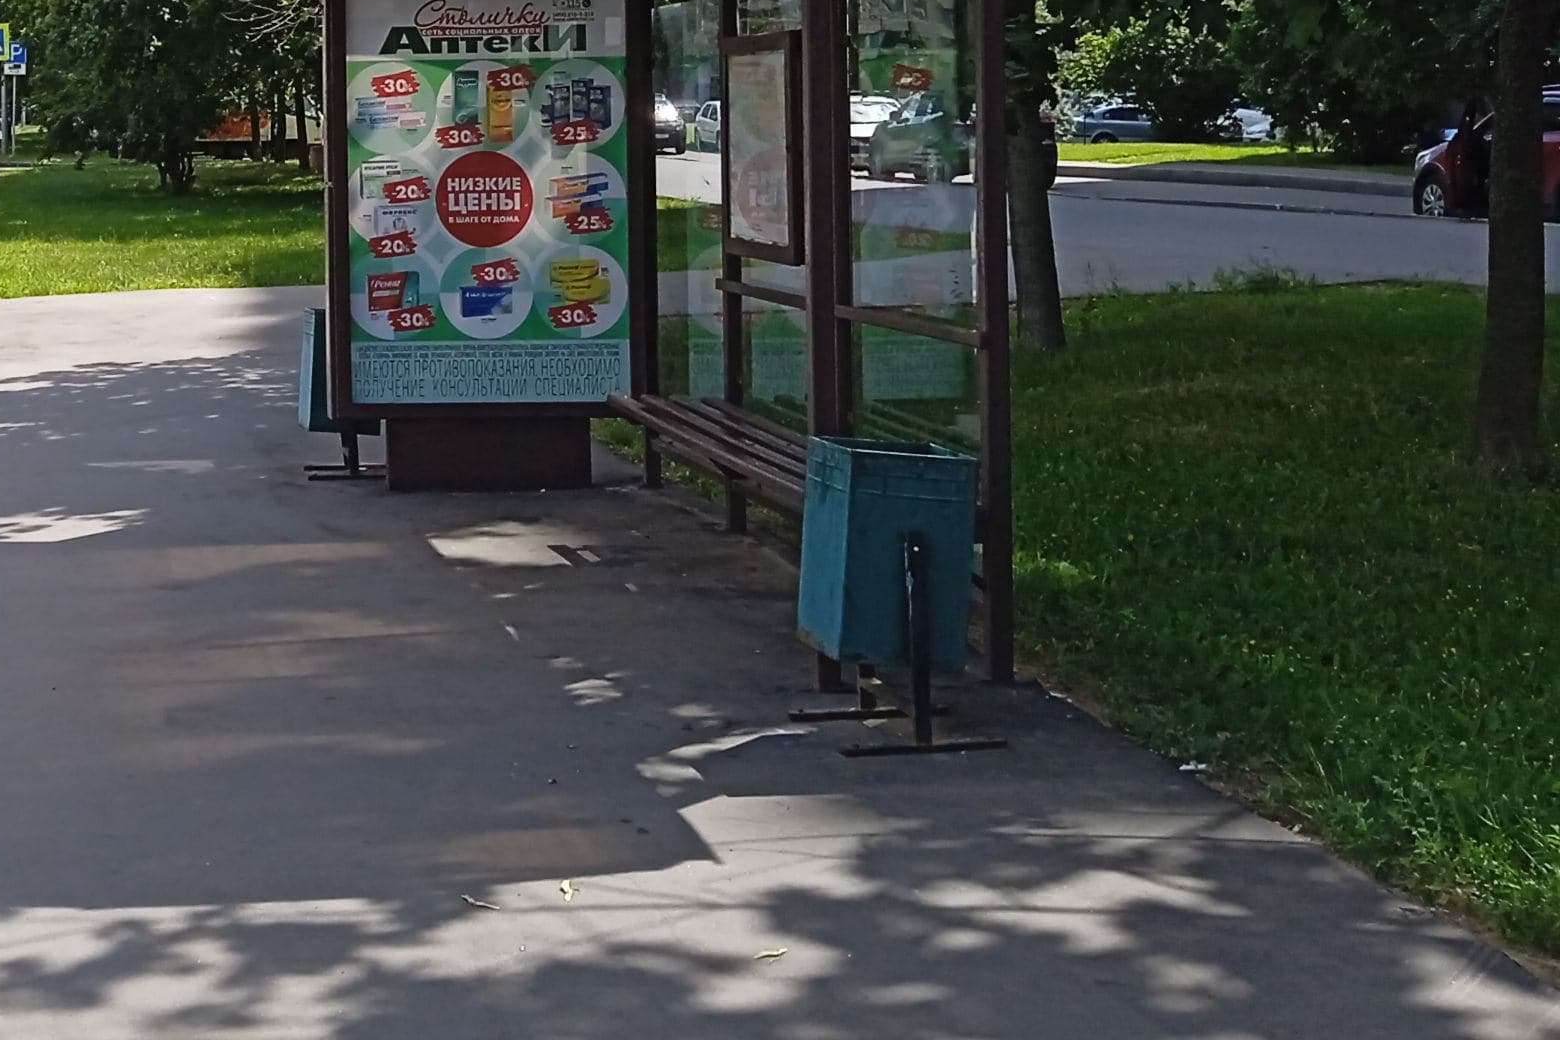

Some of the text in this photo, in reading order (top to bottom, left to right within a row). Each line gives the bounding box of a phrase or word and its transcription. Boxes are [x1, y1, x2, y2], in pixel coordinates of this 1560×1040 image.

[445, 27, 510, 36] социальных
[447, 177, 522, 192] НИЗКИЕ
[448, 192, 521, 214] ЦЕНЫ
[448, 216, 520, 224] В ШАГЕ ОТ ДОМА
[354, 358, 621, 378] ИМЕЮТСЯ ПРОТИВОПОКАЗАНИЯ. НЕОБХОДИМО
[354, 376, 621, 399] ПОЛУЧЕНИЕ КОНСУЛЬТАЦИИ СПЕЦИАЛИСТА
